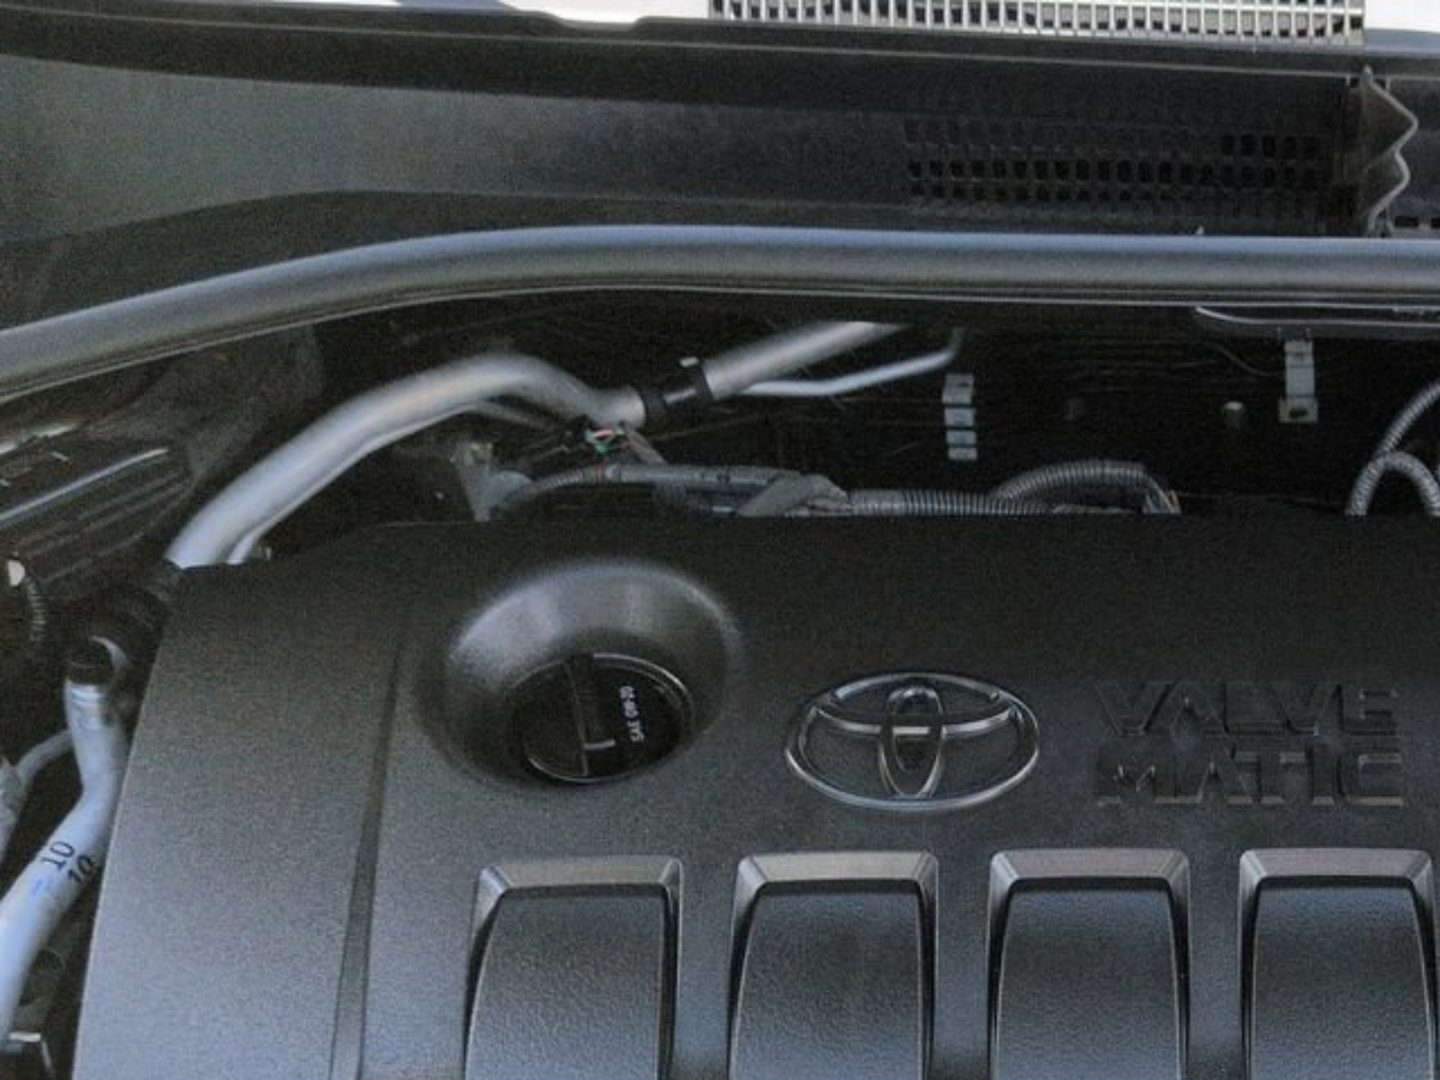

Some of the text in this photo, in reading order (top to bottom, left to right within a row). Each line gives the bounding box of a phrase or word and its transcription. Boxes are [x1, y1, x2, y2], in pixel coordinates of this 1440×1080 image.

[1094, 682, 1401, 737] VALVE
[1096, 747, 1404, 805] MATIC
[41, 841, 75, 870] 10
